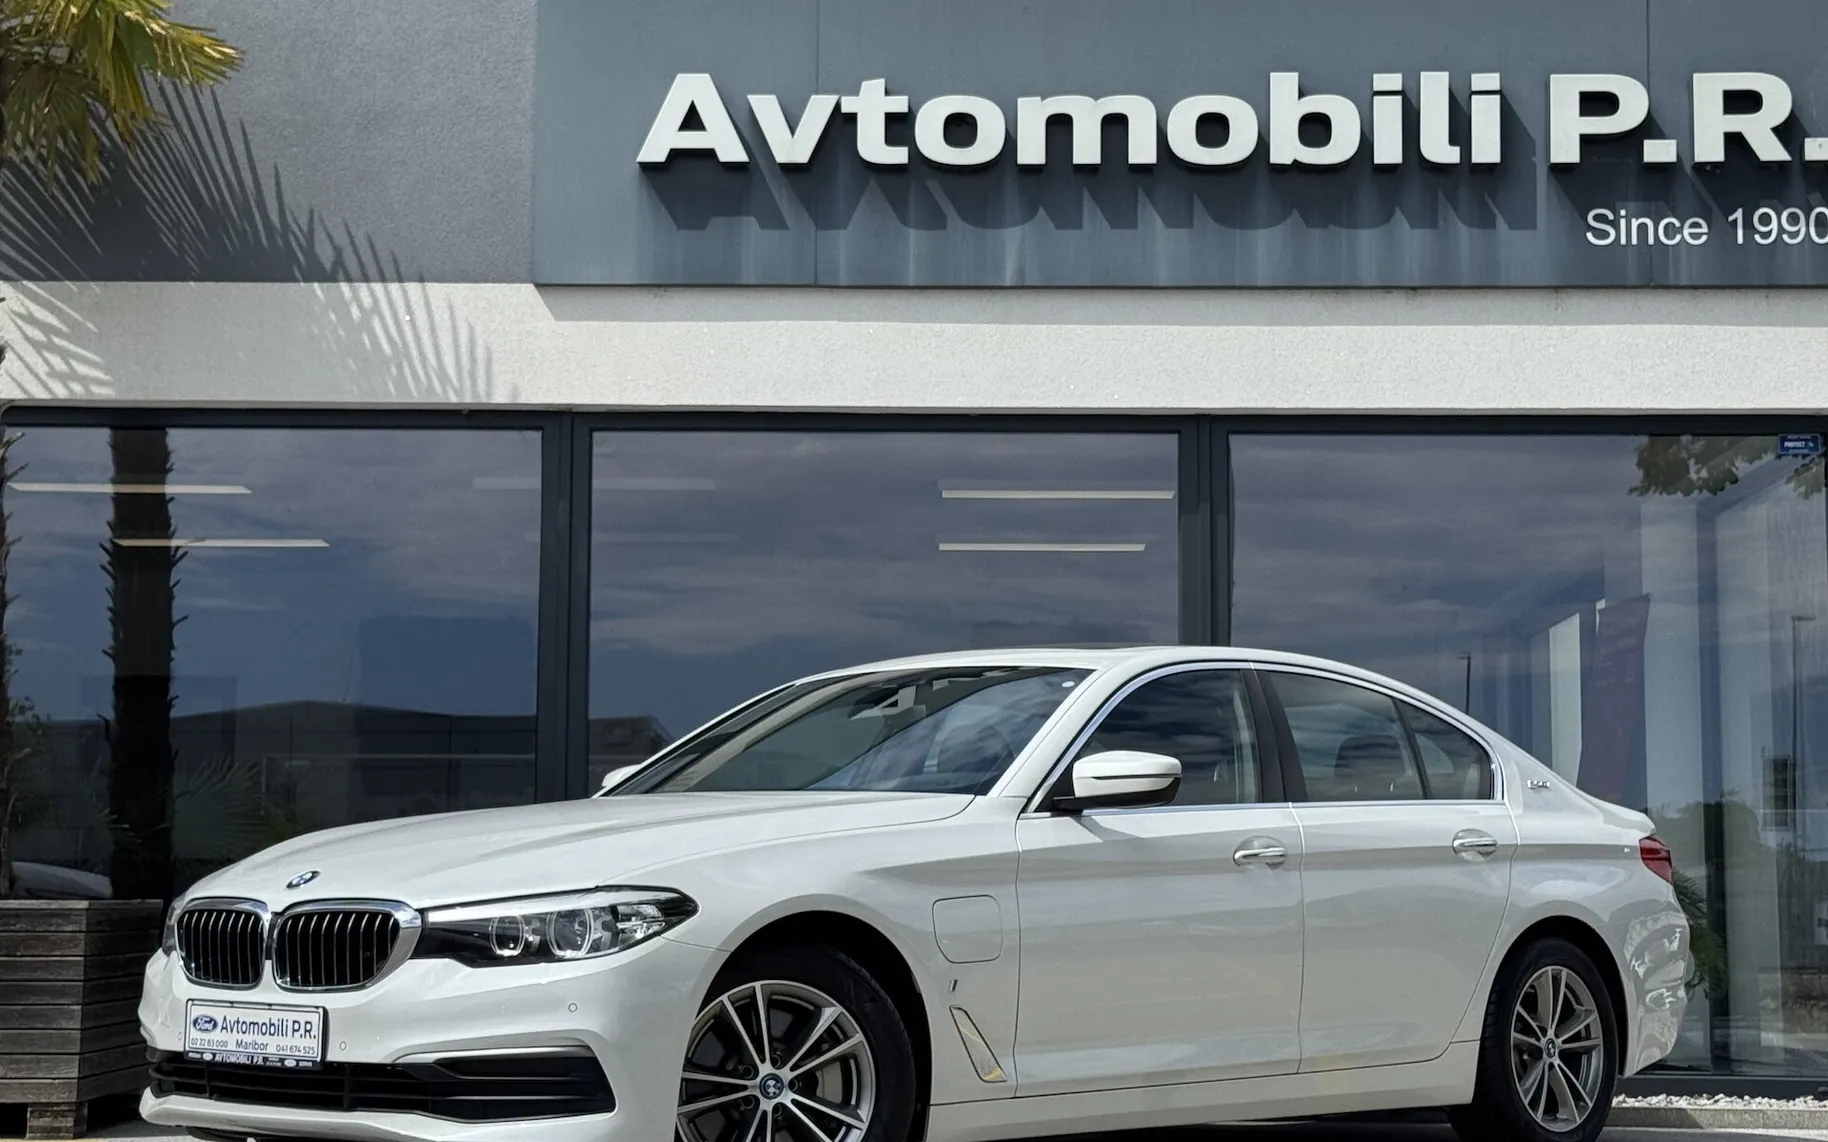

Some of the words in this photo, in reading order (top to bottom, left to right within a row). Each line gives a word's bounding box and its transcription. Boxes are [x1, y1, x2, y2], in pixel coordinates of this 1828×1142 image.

[636, 71, 1501, 166] Avtomobili
[1549, 71, 1828, 164] P.R.
[1585, 208, 1709, 246] Since
[1728, 206, 1828, 245] 1990
[195, 1016, 215, 1030] Ford
[220, 1015, 289, 1037] Avtomobili
[292, 1020, 316, 1039] P.R.
[216, 1039, 228, 1048] 000
[236, 1038, 268, 1051] Maribor
[276, 1044, 288, 1053] 041
[303, 1046, 316, 1055] 525
